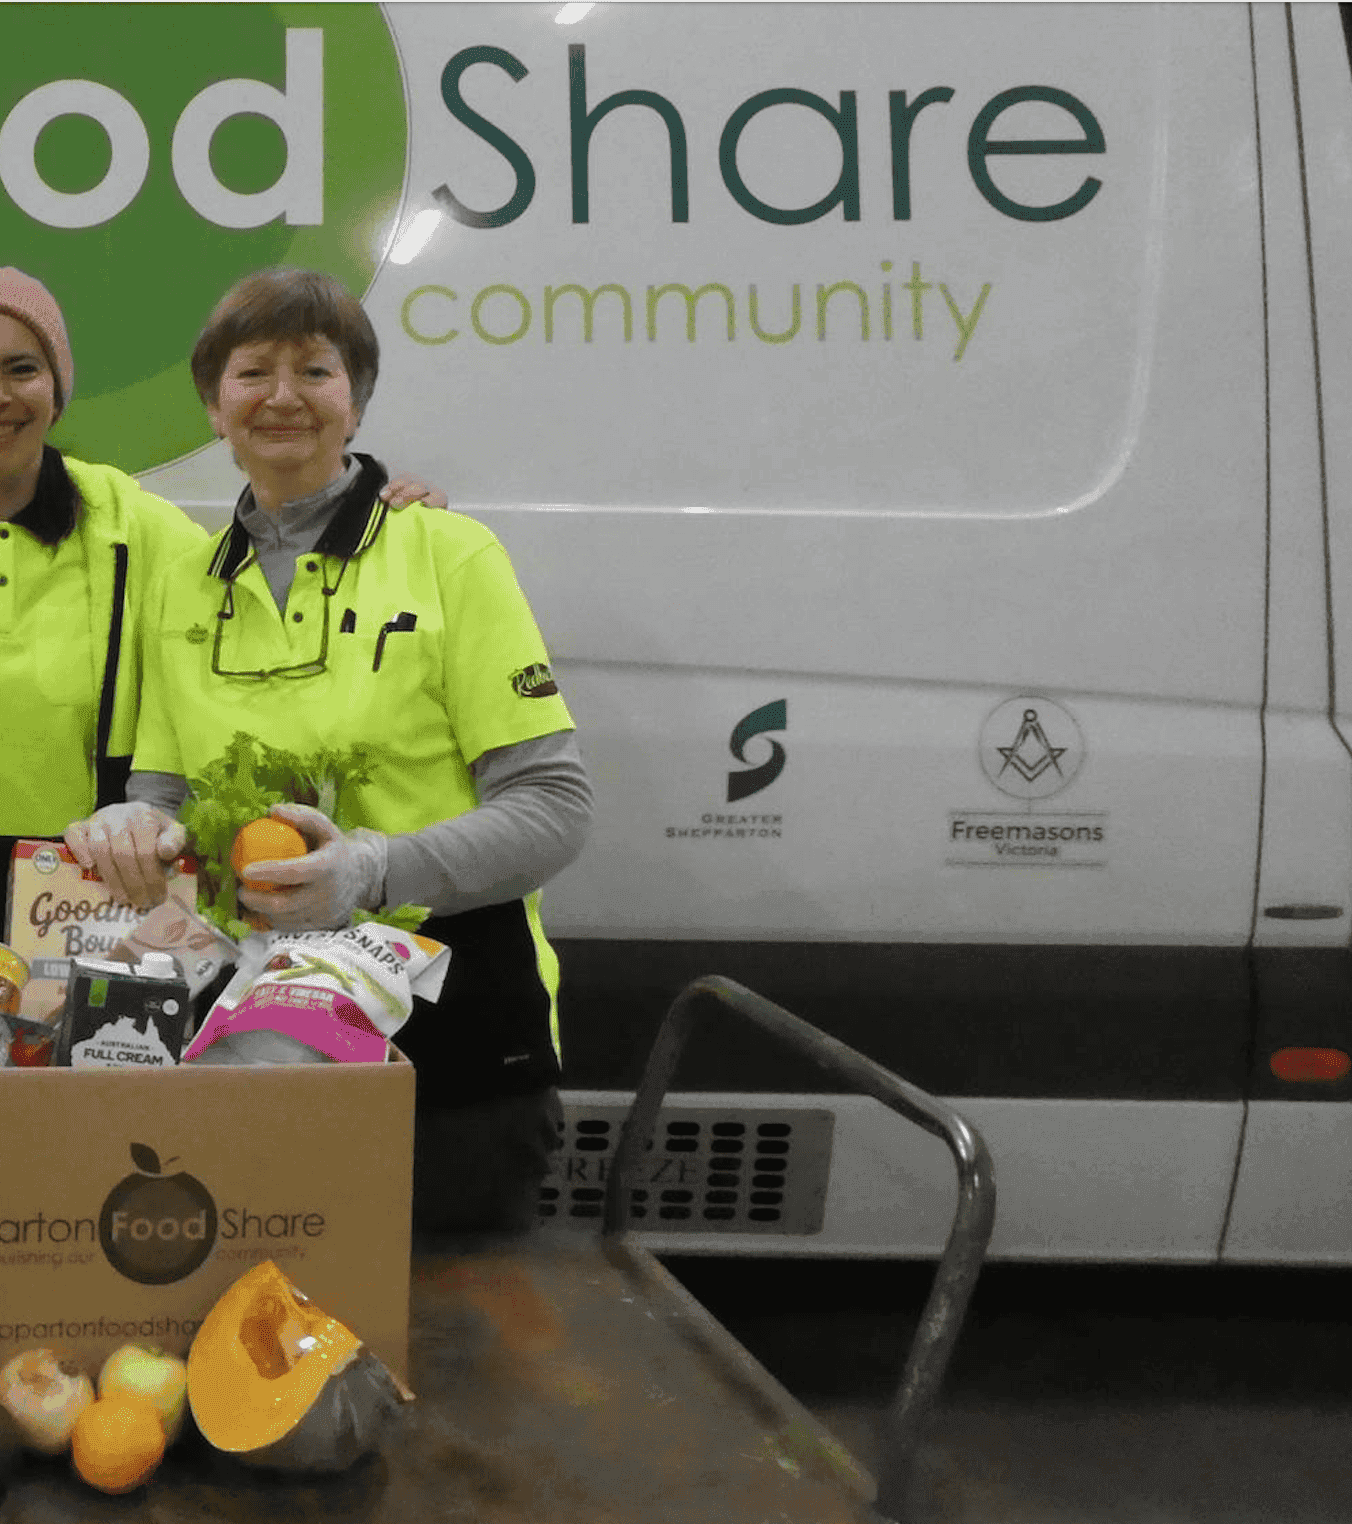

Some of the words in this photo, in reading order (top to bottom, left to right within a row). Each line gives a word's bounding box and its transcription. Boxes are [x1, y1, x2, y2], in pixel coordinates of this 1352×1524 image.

[432, 43, 1107, 229] Share
[400, 260, 993, 362] community
[951, 820, 1104, 841] Freemasons
[995, 843, 1059, 857] Victoria
[343, 928, 405, 975] SNAPS
[83, 1047, 115, 1062] FULL
[116, 1050, 164, 1067] CREAM
[111, 1209, 207, 1242] Food
[220, 1207, 326, 1240] Share
